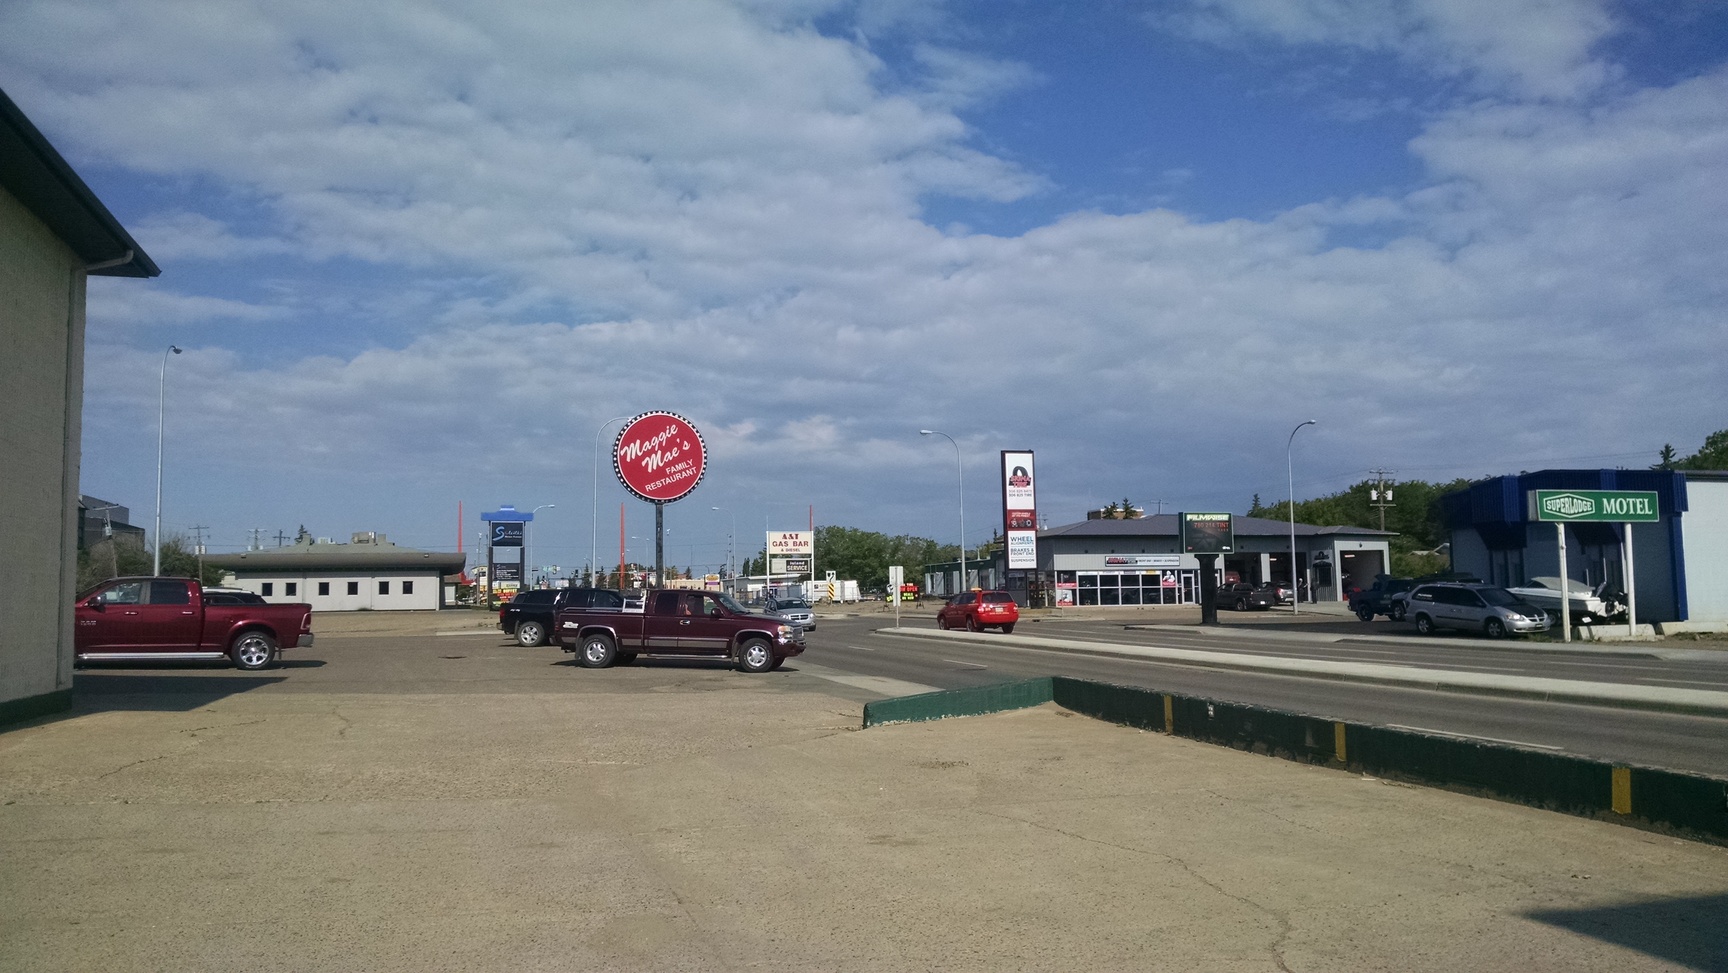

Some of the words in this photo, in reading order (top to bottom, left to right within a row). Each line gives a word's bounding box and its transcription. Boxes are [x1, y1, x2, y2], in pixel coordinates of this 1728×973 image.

[620, 424, 678, 462] Maggie
[641, 438, 690, 473] Mae's
[665, 459, 693, 474] FAMILY
[645, 467, 697, 492] RESTAURANT
[1546, 497, 1592, 514] SUPERLODGE
[1602, 497, 1653, 515] MOTEL
